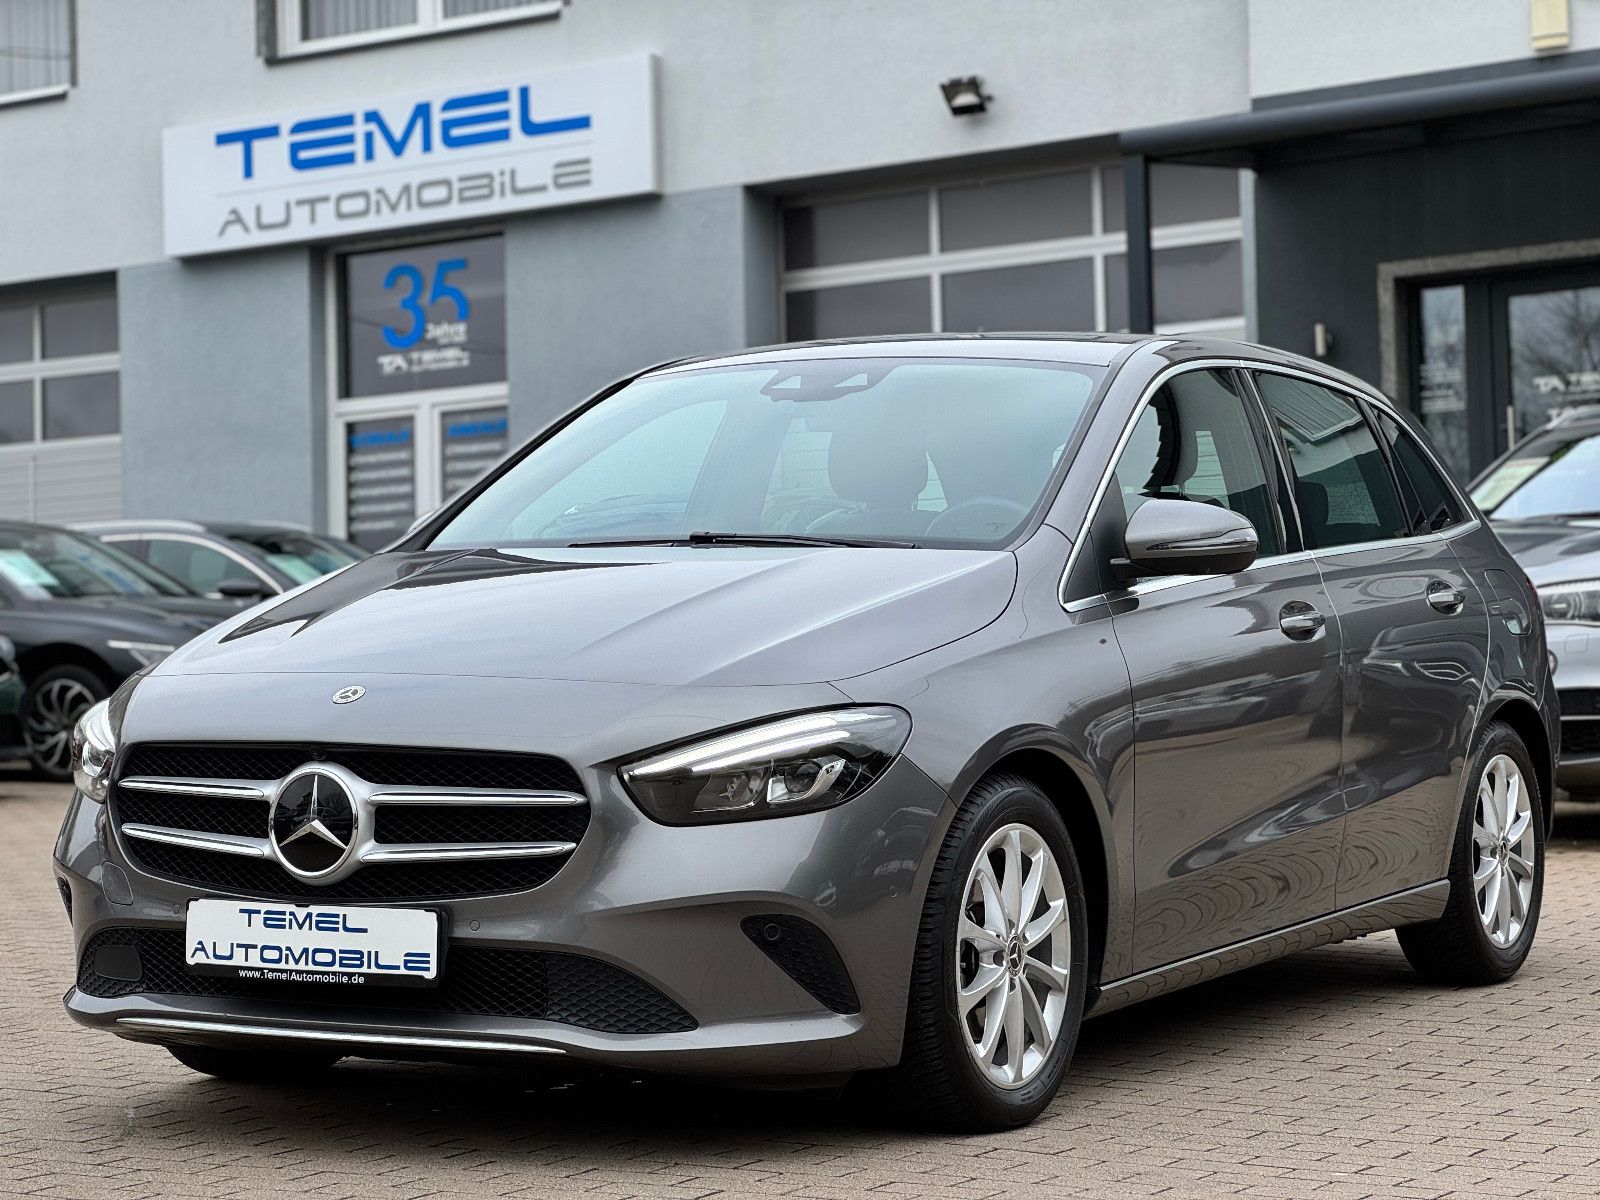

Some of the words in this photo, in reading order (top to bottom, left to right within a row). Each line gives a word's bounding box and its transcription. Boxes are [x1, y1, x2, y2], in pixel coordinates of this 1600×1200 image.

[215, 85, 592, 180] TEMEL
[381, 257, 471, 351] 35
[238, 908, 369, 933] TEMEL
[190, 940, 431, 972] AUTOMOBILE
[238, 968, 365, 984] www.TemelAutomobile.de
